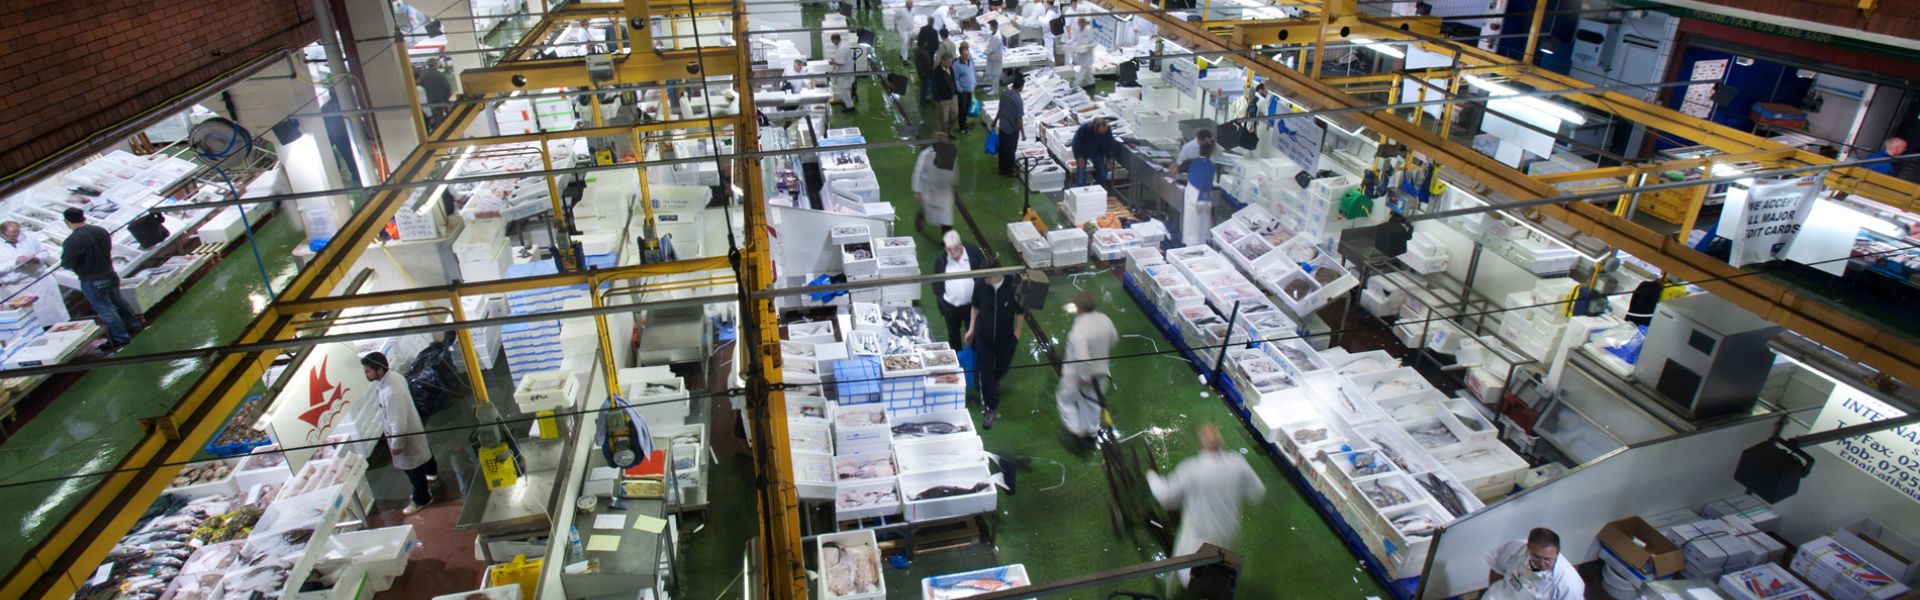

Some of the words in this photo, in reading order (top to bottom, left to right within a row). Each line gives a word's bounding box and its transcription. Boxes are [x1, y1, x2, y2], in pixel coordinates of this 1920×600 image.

[1762, 210, 1796, 223] MAJOR
[1765, 224, 1801, 236] CARDS
[1836, 438, 1875, 464] Mob:
[1878, 460, 1920, 491] 0795
[1897, 455, 1920, 475] 02
